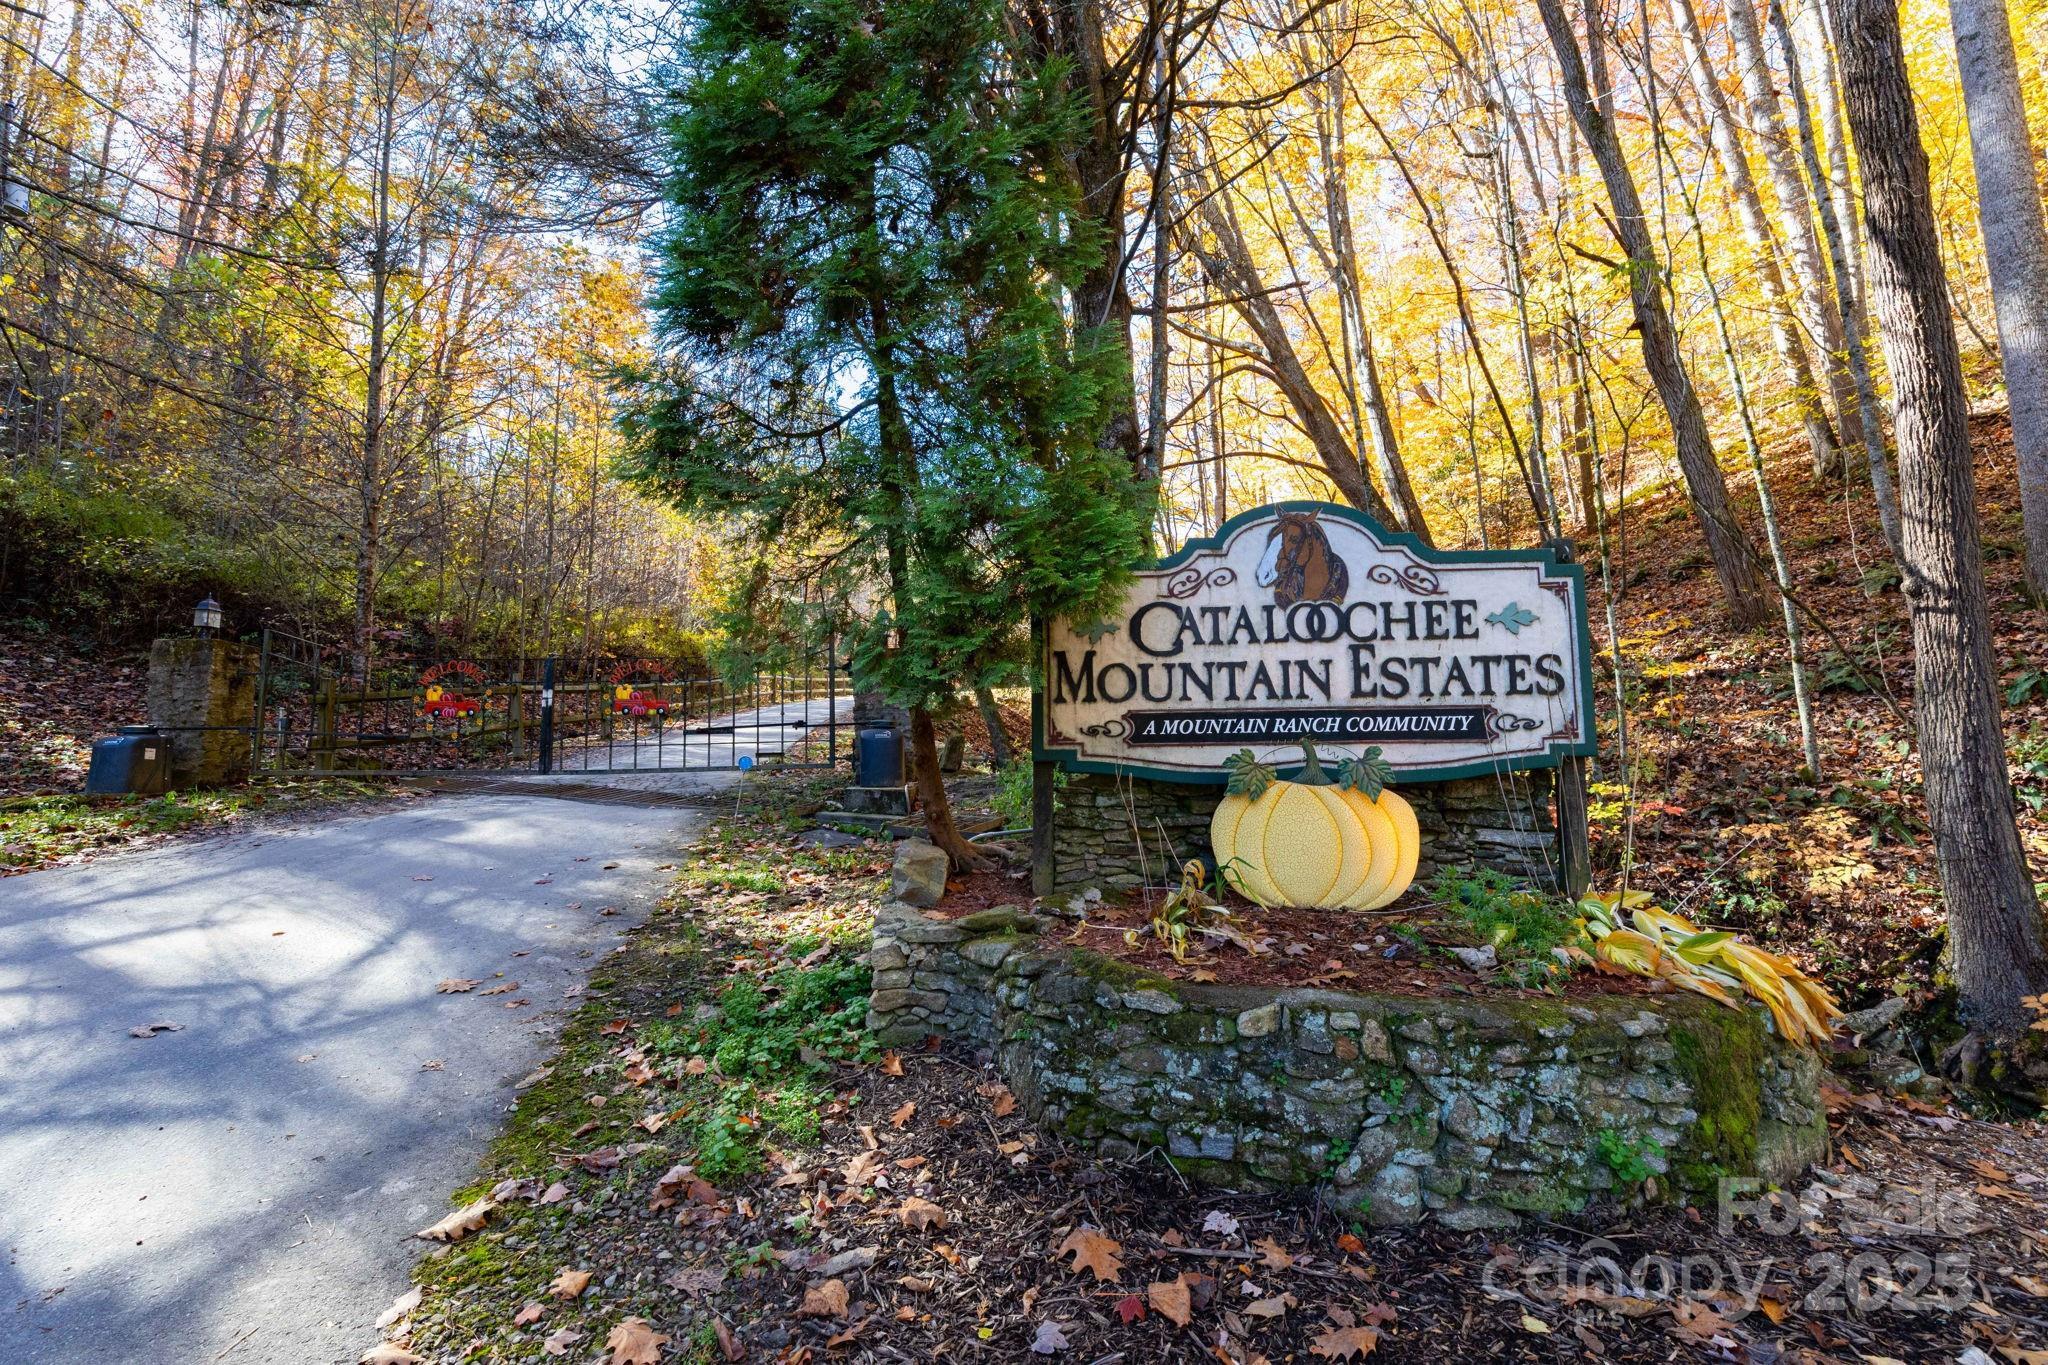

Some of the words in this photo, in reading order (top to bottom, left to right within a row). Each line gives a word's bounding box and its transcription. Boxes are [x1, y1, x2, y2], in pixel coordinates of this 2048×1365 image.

[1129, 599, 1480, 657] CATALOOCHEE
[416, 659, 490, 686] WELCOME
[608, 658, 679, 684] WELCOME
[1053, 649, 1332, 703] MOUNTAIN
[1348, 643, 1566, 699] ESTATES
[1142, 720, 1156, 736] A
[1161, 718, 1269, 736] MOUNTAIN
[1273, 716, 1342, 733] RANCH
[1346, 714, 1474, 732] COMMUNITY
